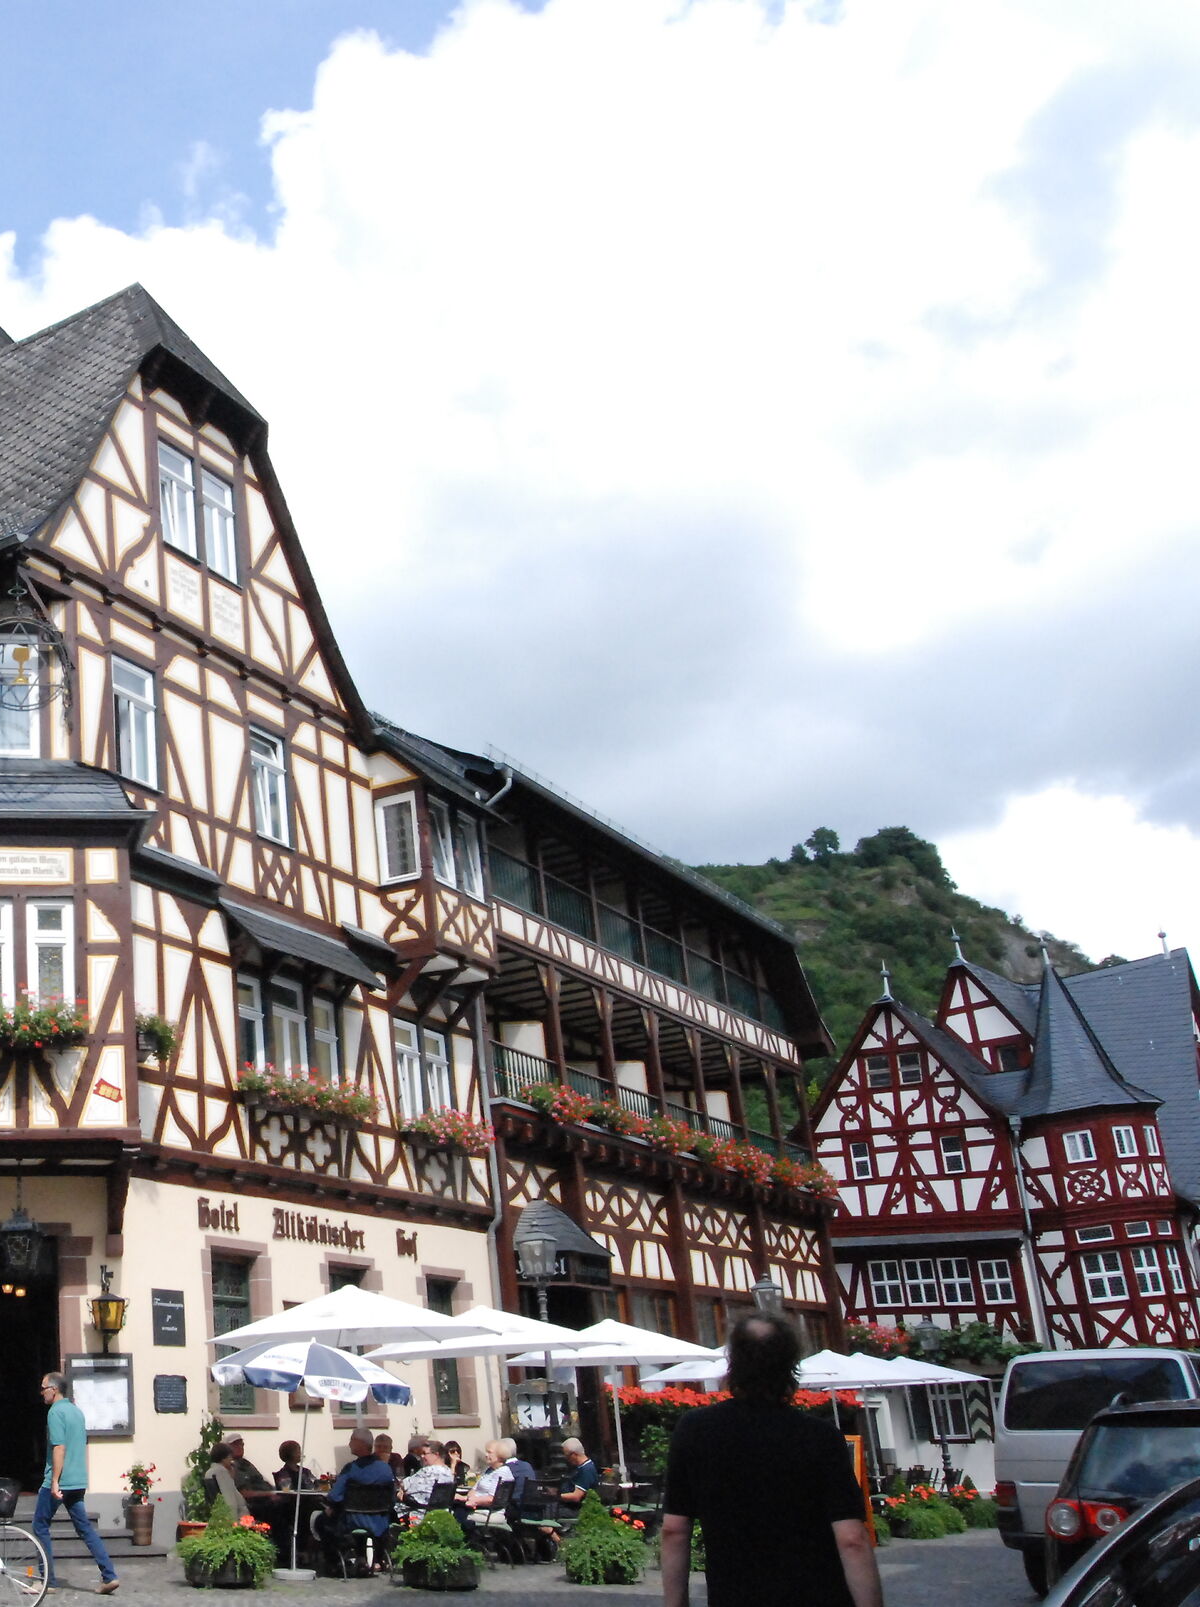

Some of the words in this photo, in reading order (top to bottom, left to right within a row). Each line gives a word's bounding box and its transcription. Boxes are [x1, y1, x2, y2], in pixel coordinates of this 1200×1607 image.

[198, 1196, 240, 1231] Hotel
[272, 1207, 366, 1253] Altkölnischer
[396, 1228, 418, 1262] Hof
